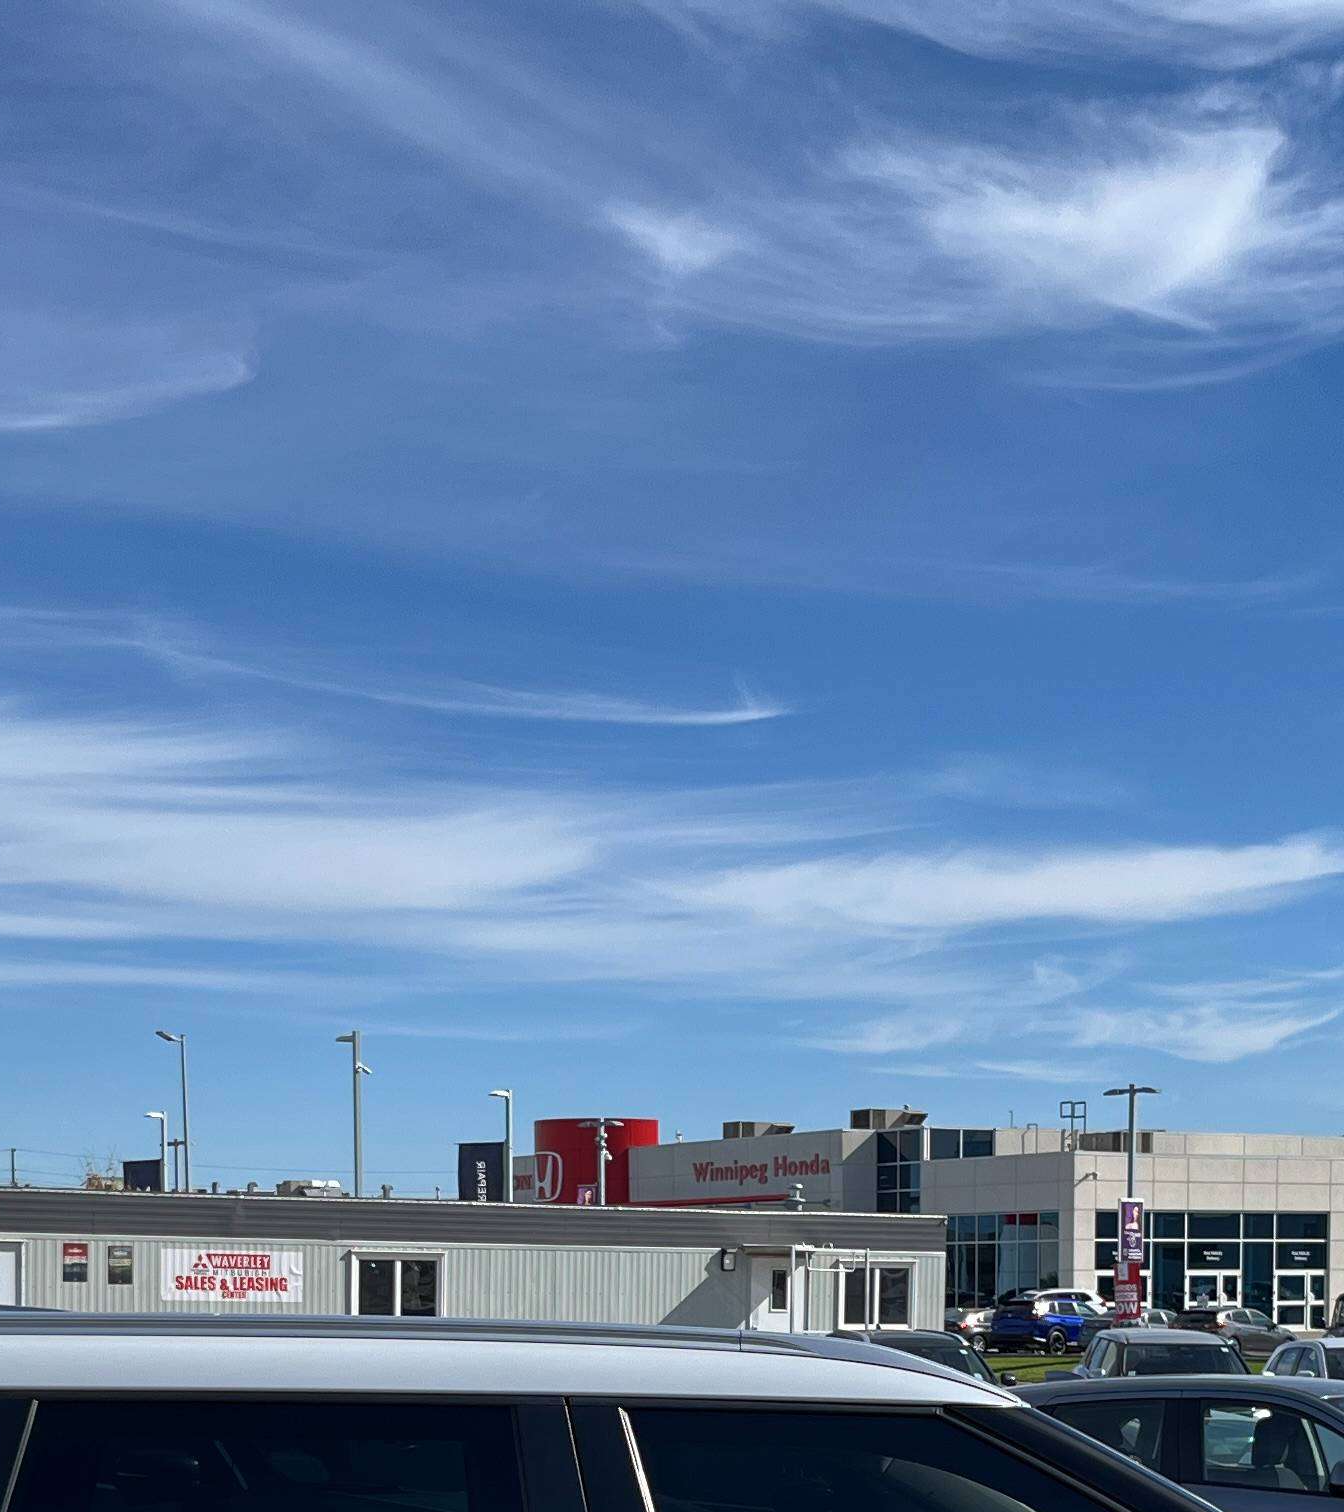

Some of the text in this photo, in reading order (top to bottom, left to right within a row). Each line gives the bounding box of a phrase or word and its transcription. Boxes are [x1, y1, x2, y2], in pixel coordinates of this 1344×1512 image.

[692, 1153, 831, 1185] Winnipeg Honda
[211, 1256, 270, 1268] WAVERLEY
[176, 1275, 288, 1292] SALES & LEASING
